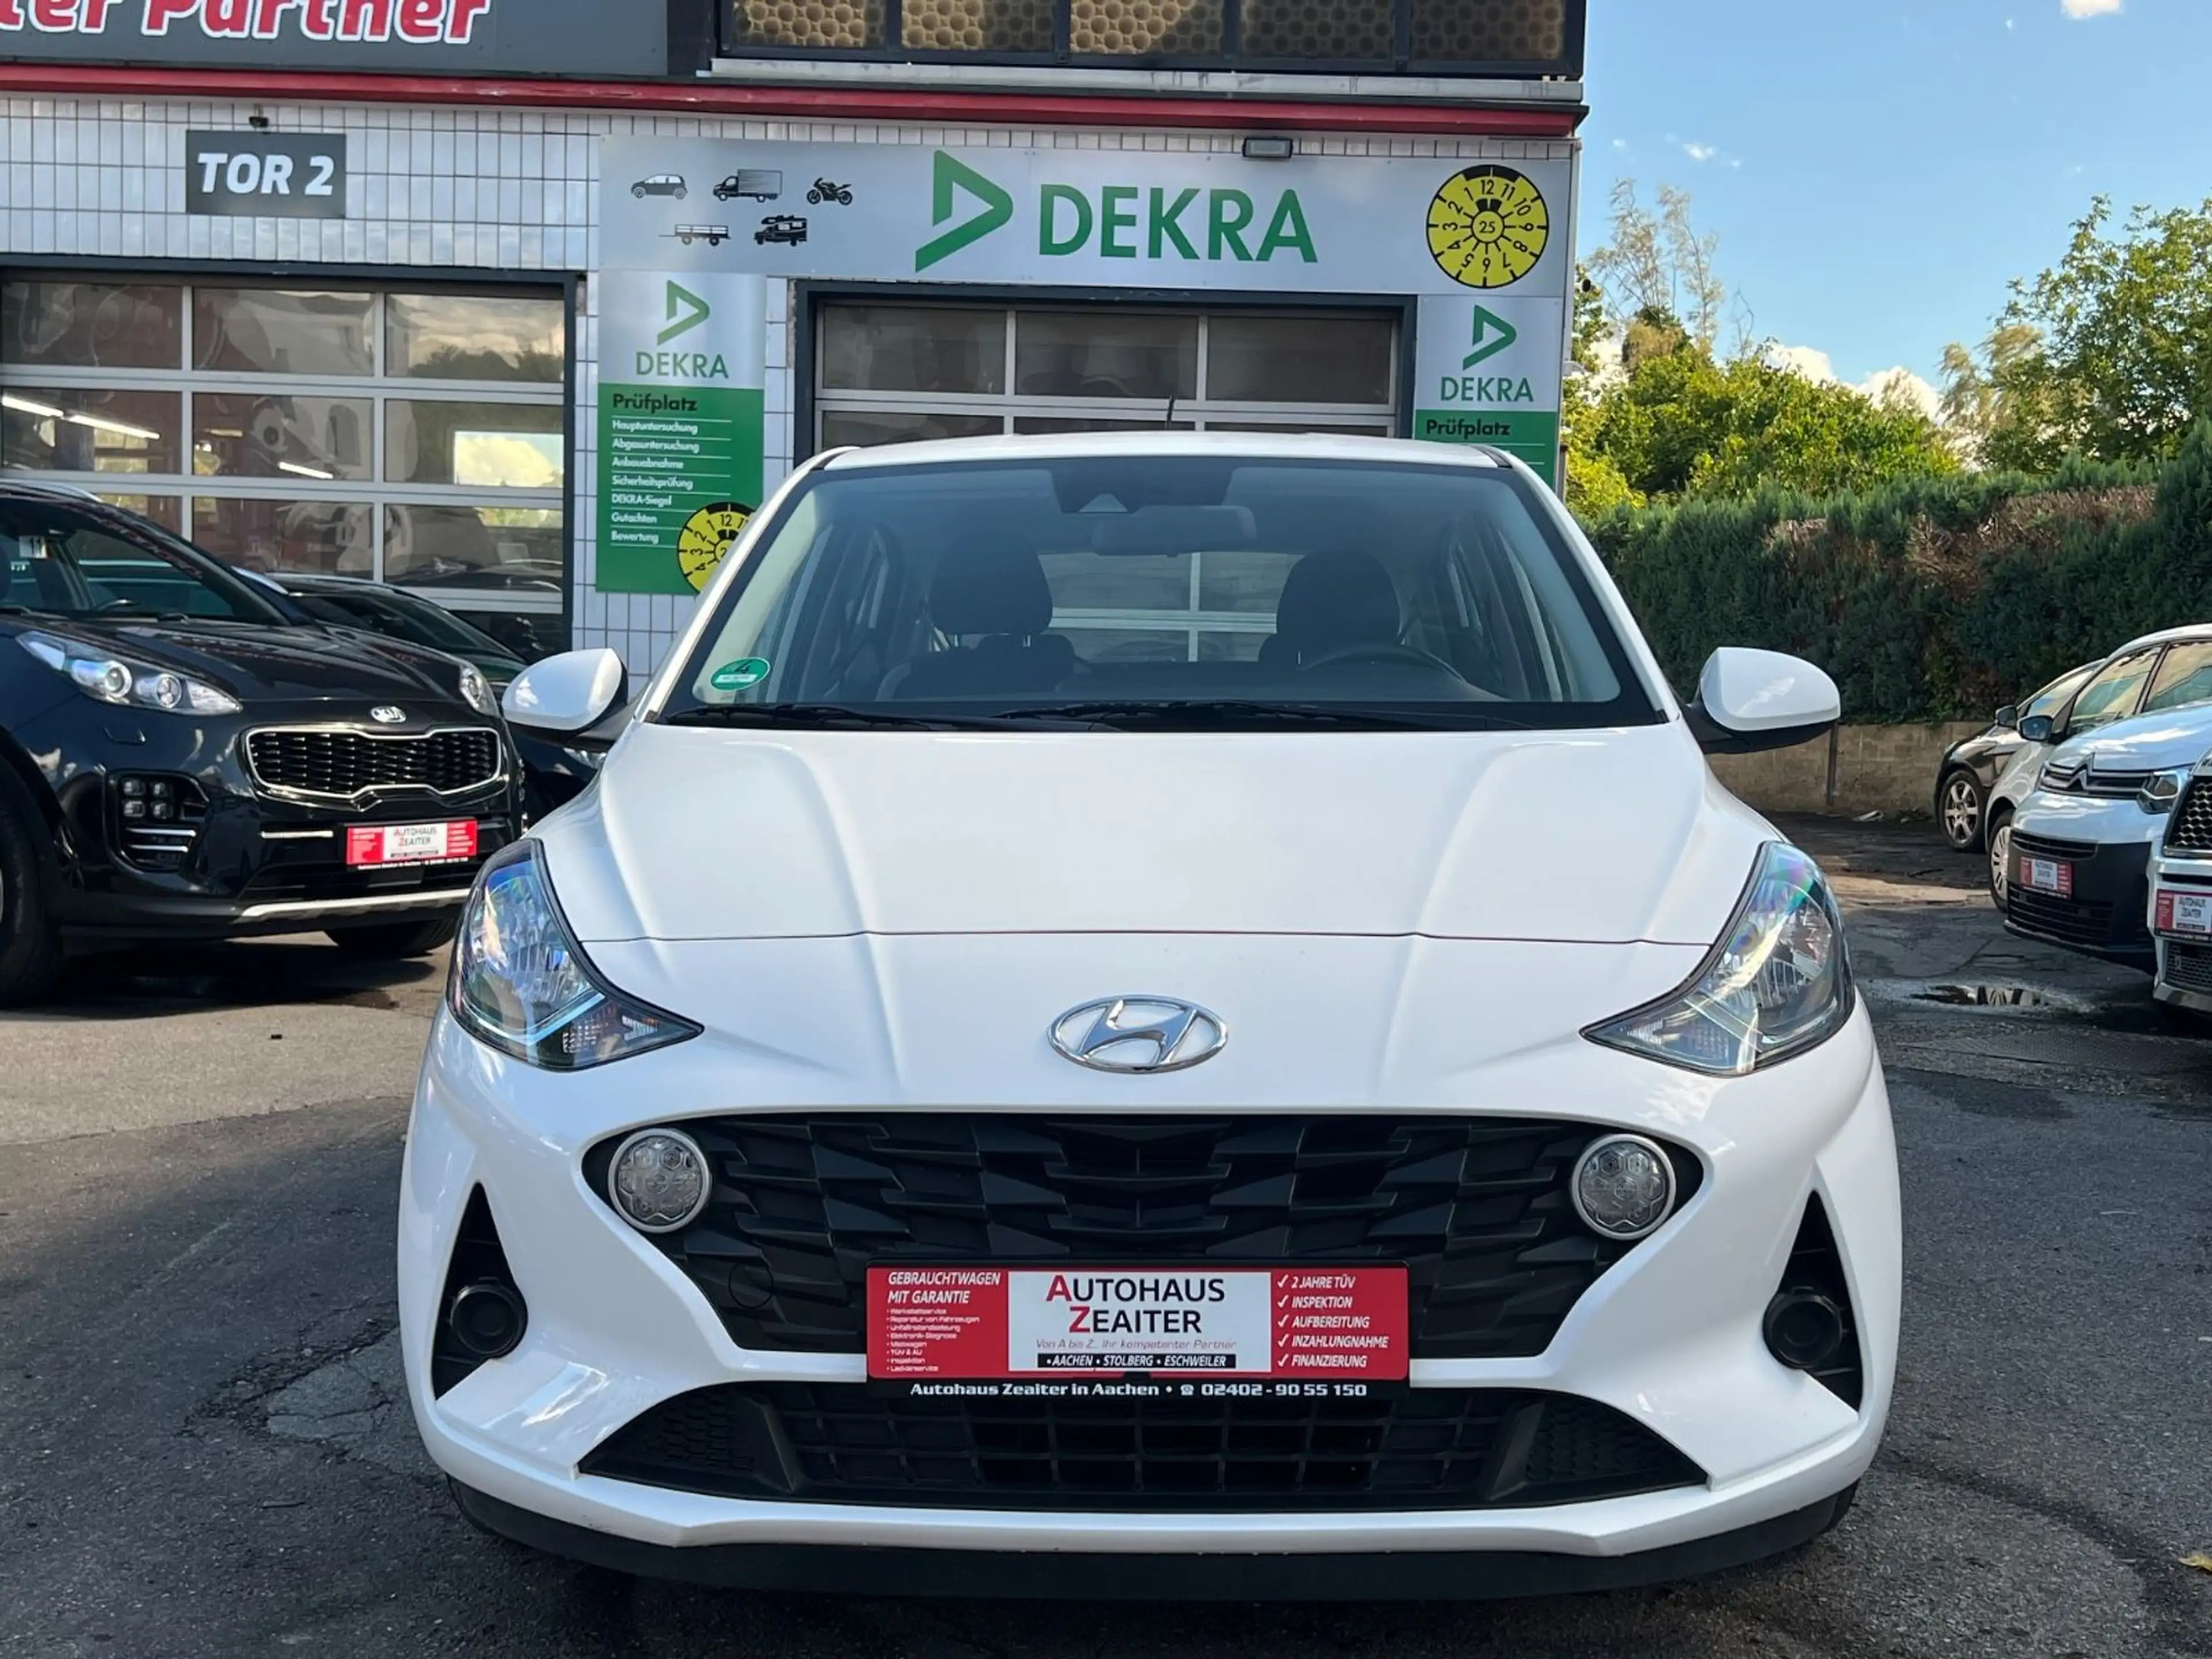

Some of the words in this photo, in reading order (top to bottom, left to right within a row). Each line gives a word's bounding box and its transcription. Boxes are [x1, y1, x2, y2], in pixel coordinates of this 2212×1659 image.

[141, 0, 490, 44] Partner
[197, 153, 293, 195] TOR
[305, 156, 334, 195] 2
[1464, 187, 1474, 201] 1
[1480, 180, 1494, 195] 12
[1501, 183, 1515, 200] 11
[1448, 201, 1463, 214] 2
[1514, 198, 1531, 216] 10
[1039, 184, 1318, 263] DEKRA
[1442, 222, 1458, 230] 3
[1479, 221, 1495, 233] 25
[1447, 240, 1461, 249] 4
[1513, 241, 1528, 252] 8
[1461, 253, 1475, 268] 5
[1503, 252, 1512, 268] 7
[635, 351, 729, 378] DEKRA
[1440, 377, 1534, 402] DEKRA
[613, 393, 698, 414] Prüfplatz
[612, 420, 698, 435] Hauptuntersuchung
[1426, 418, 1510, 440] Prüfplatz
[612, 437, 699, 454] Abgasuntersuchung
[612, 475, 693, 490] Sicherheitsprüfung
[612, 493, 672, 507] DEKRA-Siegel
[611, 512, 657, 523] Gutachten
[720, 514, 732, 527] 12
[611, 530, 659, 544] Bewertung
[694, 531, 707, 543] 2
[888, 1272, 1001, 1285] GEBRAUCHTWAGEN
[1291, 1277, 1298, 1288] 2
[1299, 1276, 1332, 1289] JAHRE
[1334, 1274, 1355, 1289] TÜV
[1046, 1274, 1225, 1302] AUTOHAUS
[887, 1290, 910, 1304] MIT
[912, 1290, 970, 1304] GARANTIE
[1291, 1296, 1353, 1308] INSPEKTION
[1069, 1305, 1202, 1334] ZEAITER
[1291, 1316, 1370, 1328] AUFBEREITUNG
[1037, 1339, 1055, 1349] Von
[1121, 1339, 1191, 1350] kompetenter
[1194, 1339, 1236, 1349] Partner
[1291, 1335, 1389, 1348] INZAHLUNGNAHME
[1052, 1355, 1093, 1366] AACHEN
[1103, 1355, 1153, 1366] STOLBERG
[1164, 1355, 1226, 1366] ESCHWEILER
[1291, 1355, 1368, 1368] FINANZIERUNG
[910, 1383, 998, 1396] Autohaus
[1002, 1383, 1067, 1396] Zeaiter
[1071, 1383, 1088, 1396] in
[1092, 1383, 1159, 1396] Aachen
[1201, 1384, 1263, 1396] 02402
[1275, 1384, 1300, 1396] 90
[1304, 1384, 1328, 1396] 55
[1333, 1384, 1367, 1396] 150
